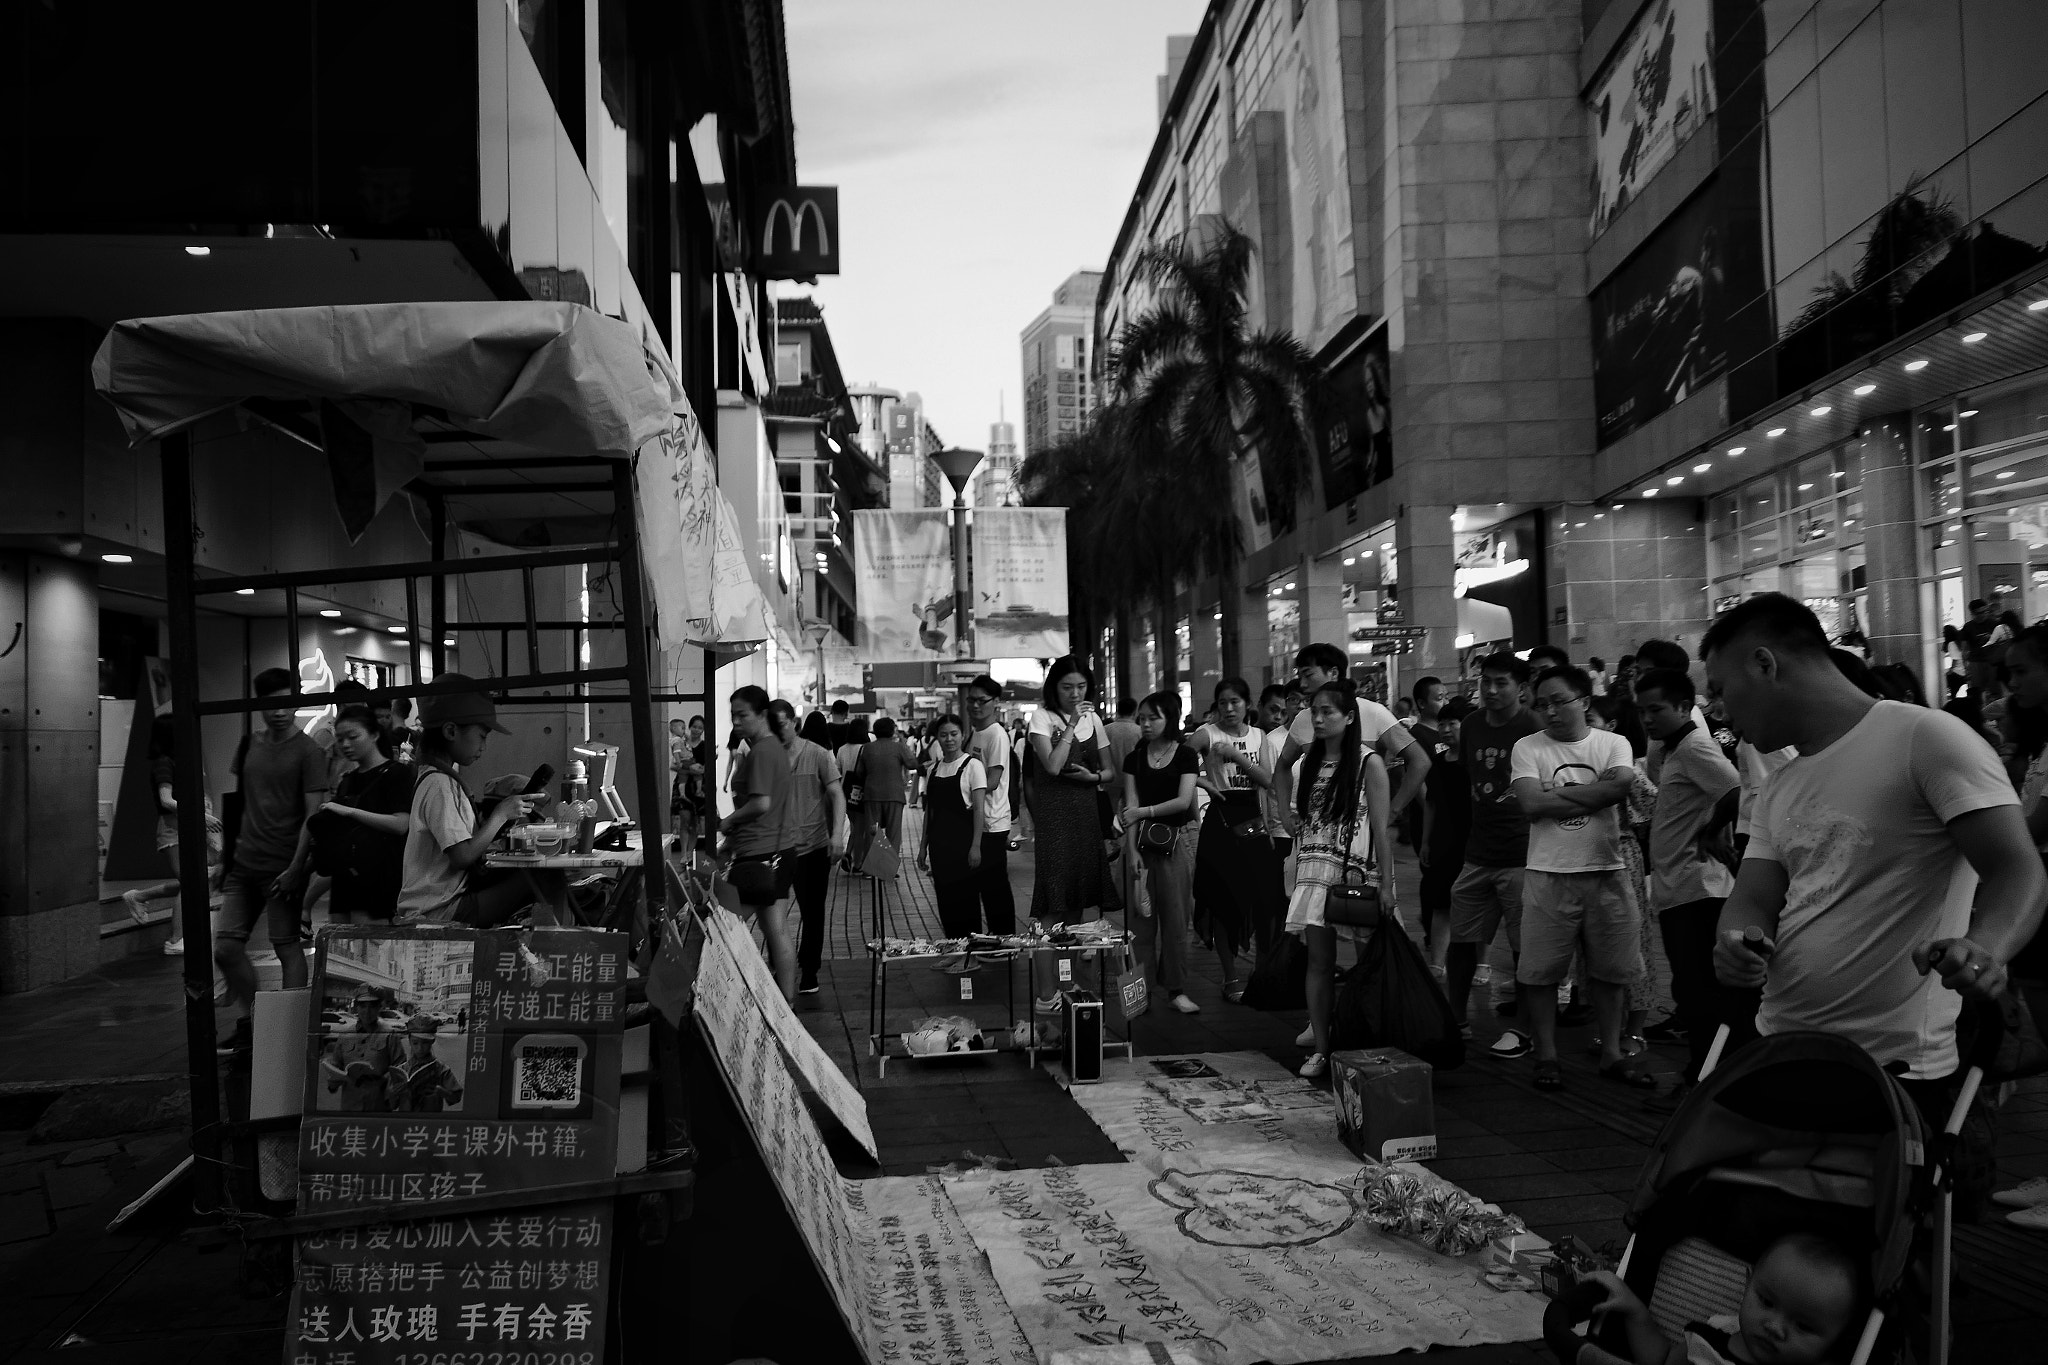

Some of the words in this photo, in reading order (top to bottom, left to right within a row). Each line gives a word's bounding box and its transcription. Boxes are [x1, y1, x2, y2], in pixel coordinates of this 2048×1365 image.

[493, 990, 617, 1023] 传递正能量
[469, 979, 493, 1073] 朗读者目的
[309, 1126, 586, 1158] 收集小学生课外书籍，
[309, 1172, 487, 1203] 帮助山区孩子
[302, 1260, 445, 1294] 志愿搭把手
[459, 1260, 599, 1291] 公益创梦想
[298, 1304, 438, 1343] 送人玫瑰
[457, 1302, 593, 1342] 手有余香
